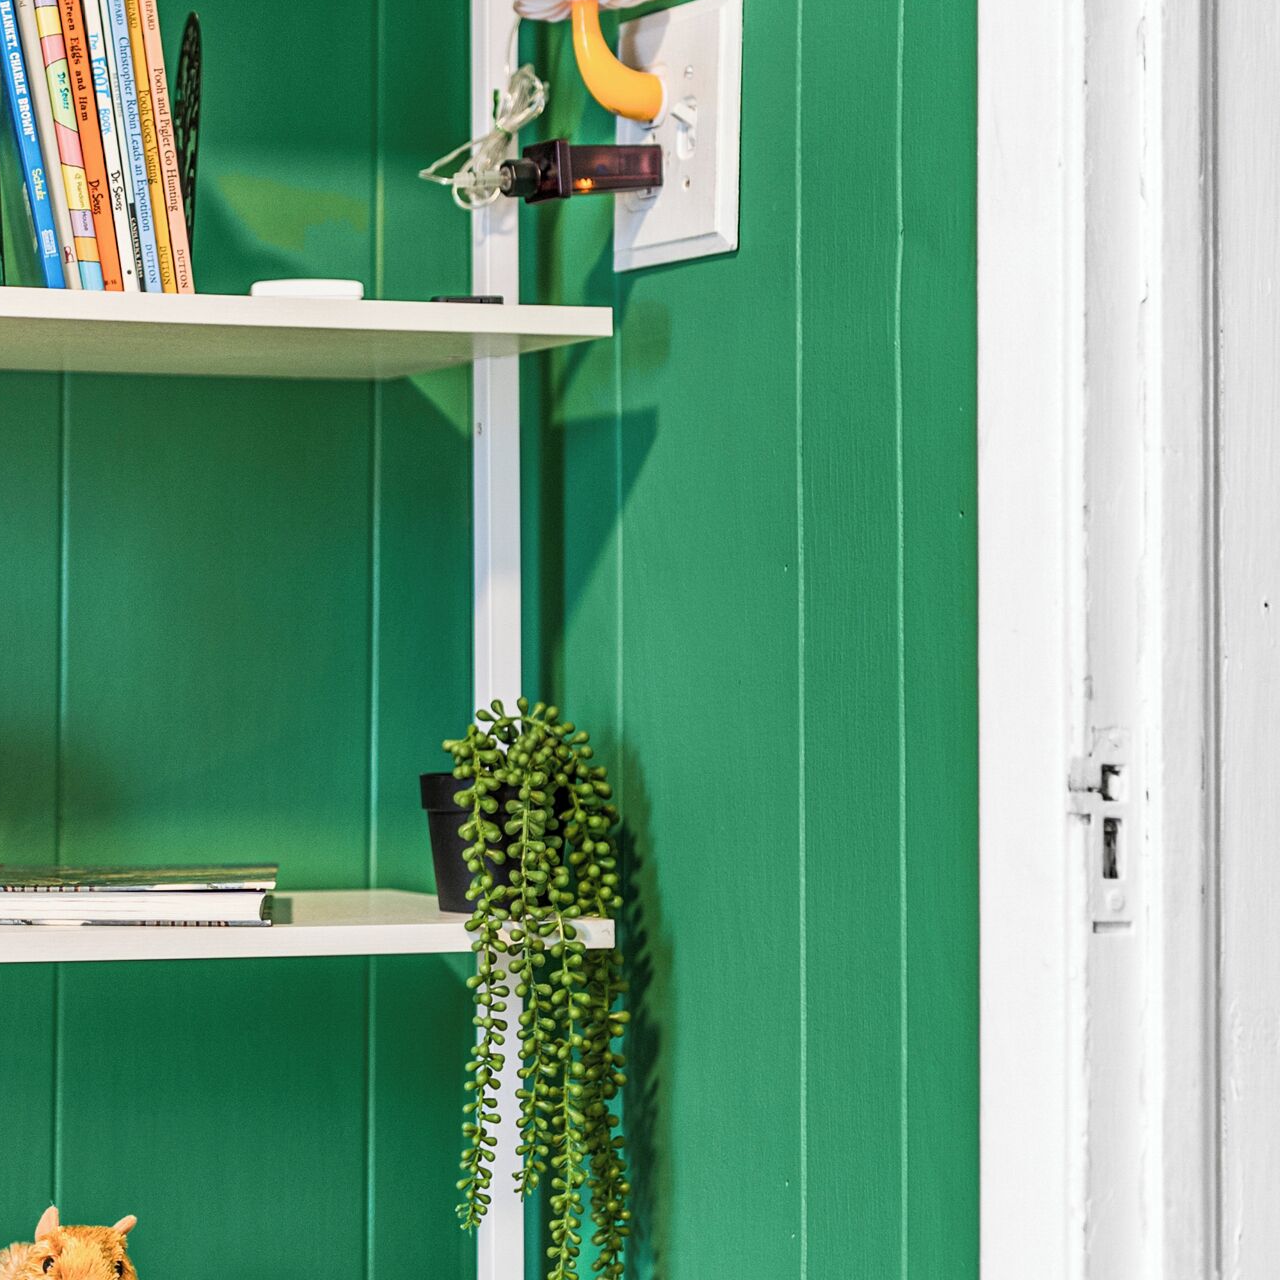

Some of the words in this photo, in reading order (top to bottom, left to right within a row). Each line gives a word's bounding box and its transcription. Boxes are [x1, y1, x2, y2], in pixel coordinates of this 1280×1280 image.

[68, 36, 83, 65] Eggs
[9, 52, 26, 94] CHARLIE
[75, 70, 86, 90] and
[91, 56, 111, 100] FOOT
[115, 36, 135, 96] Christopher
[153, 67, 165, 94] Pooh
[59, 87, 71, 109] Seuss
[78, 95, 90, 121] Ham
[138, 89, 151, 115] Pooh
[157, 97, 168, 115] and
[125, 99, 139, 129] Robin
[142, 118, 154, 143] Goes
[158, 118, 172, 147] Piglet
[130, 132, 142, 160] Leads
[163, 150, 174, 166] Go
[134, 164, 141, 175] an
[144, 147, 160, 184] Visiting
[30, 167, 46, 200] Schulz
[163, 168, 180, 212] Hunting
[76, 181, 85, 208] Random
[81, 211, 89, 230] House
[91, 193, 105, 215] Seuss
[111, 186, 125, 211] Seuss
[134, 179, 151, 231] Expotition
[145, 244, 156, 283] DUTTON
[159, 245, 171, 285] DUTTON
[176, 249, 188, 288] DUTTON
